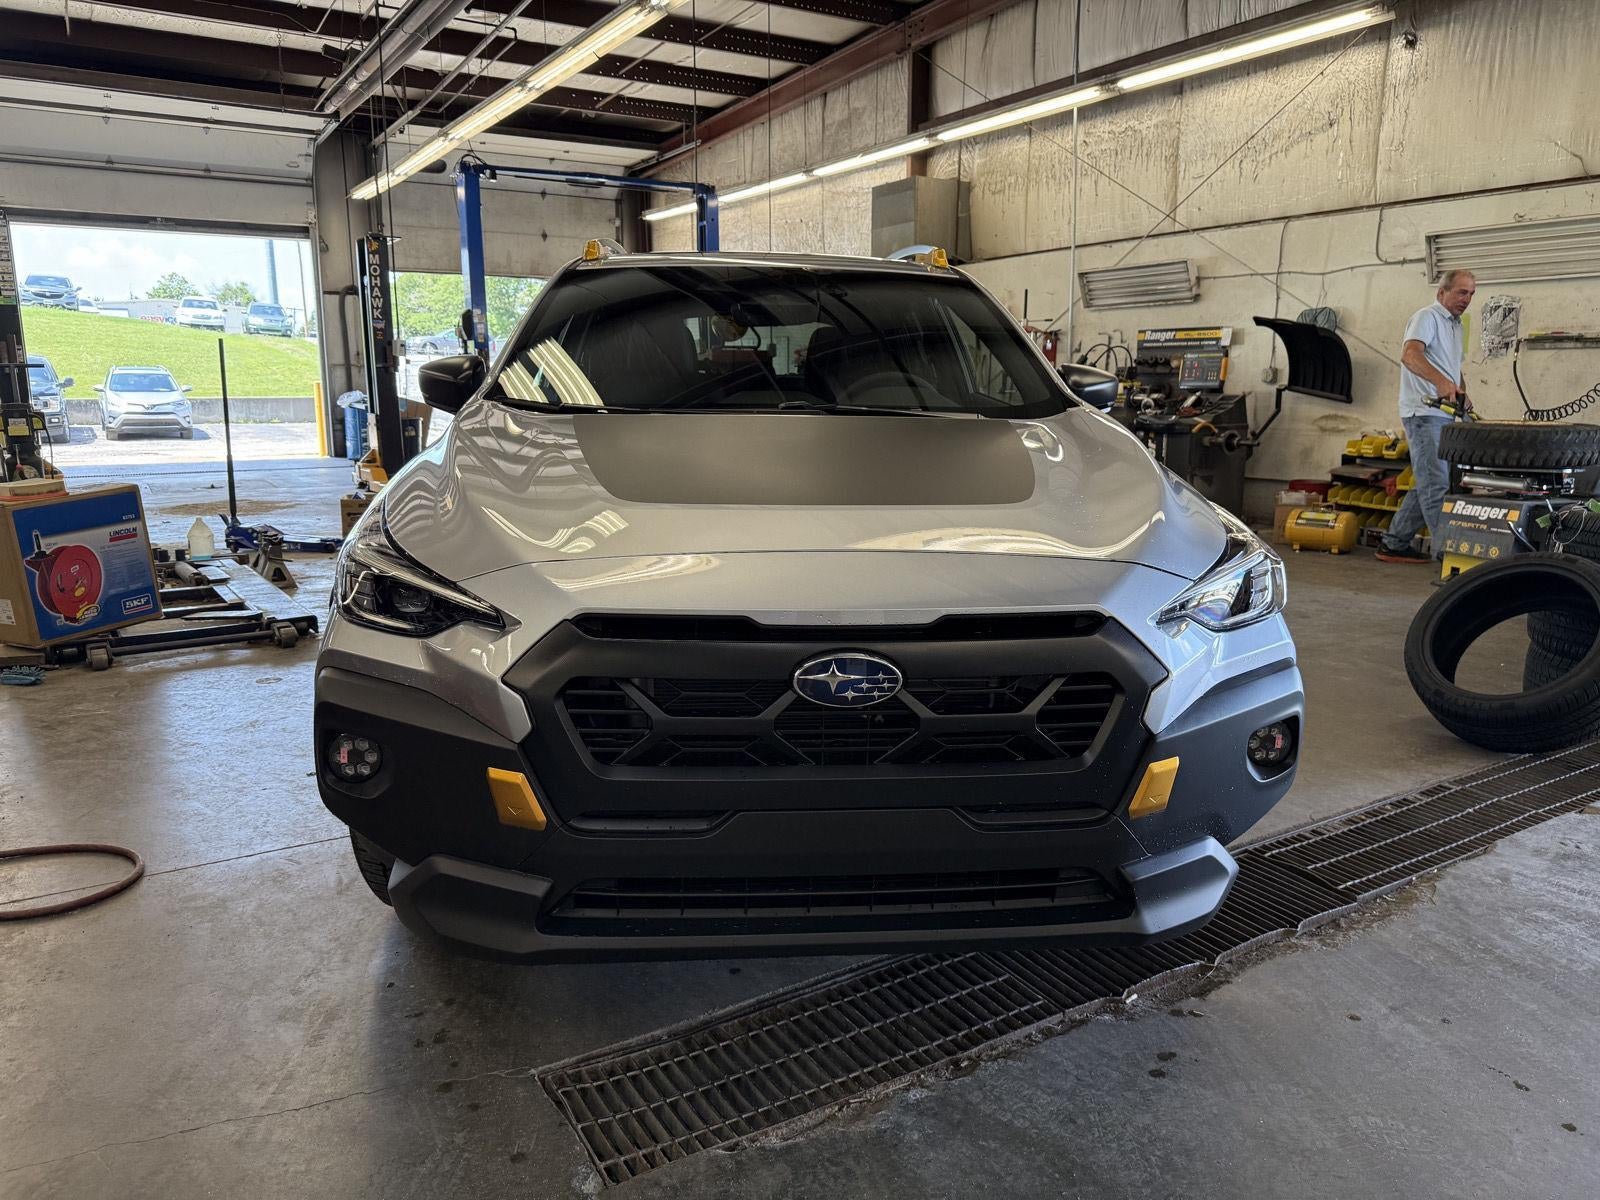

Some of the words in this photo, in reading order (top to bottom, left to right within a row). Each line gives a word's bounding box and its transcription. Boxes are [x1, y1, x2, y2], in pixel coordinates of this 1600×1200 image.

[369, 253, 382, 319] MOHAWK
[1144, 330, 1176, 341] Ranger
[1452, 500, 1509, 520] Ranger
[109, 527, 138, 537] LINCOLN
[125, 597, 149, 609] SKF
